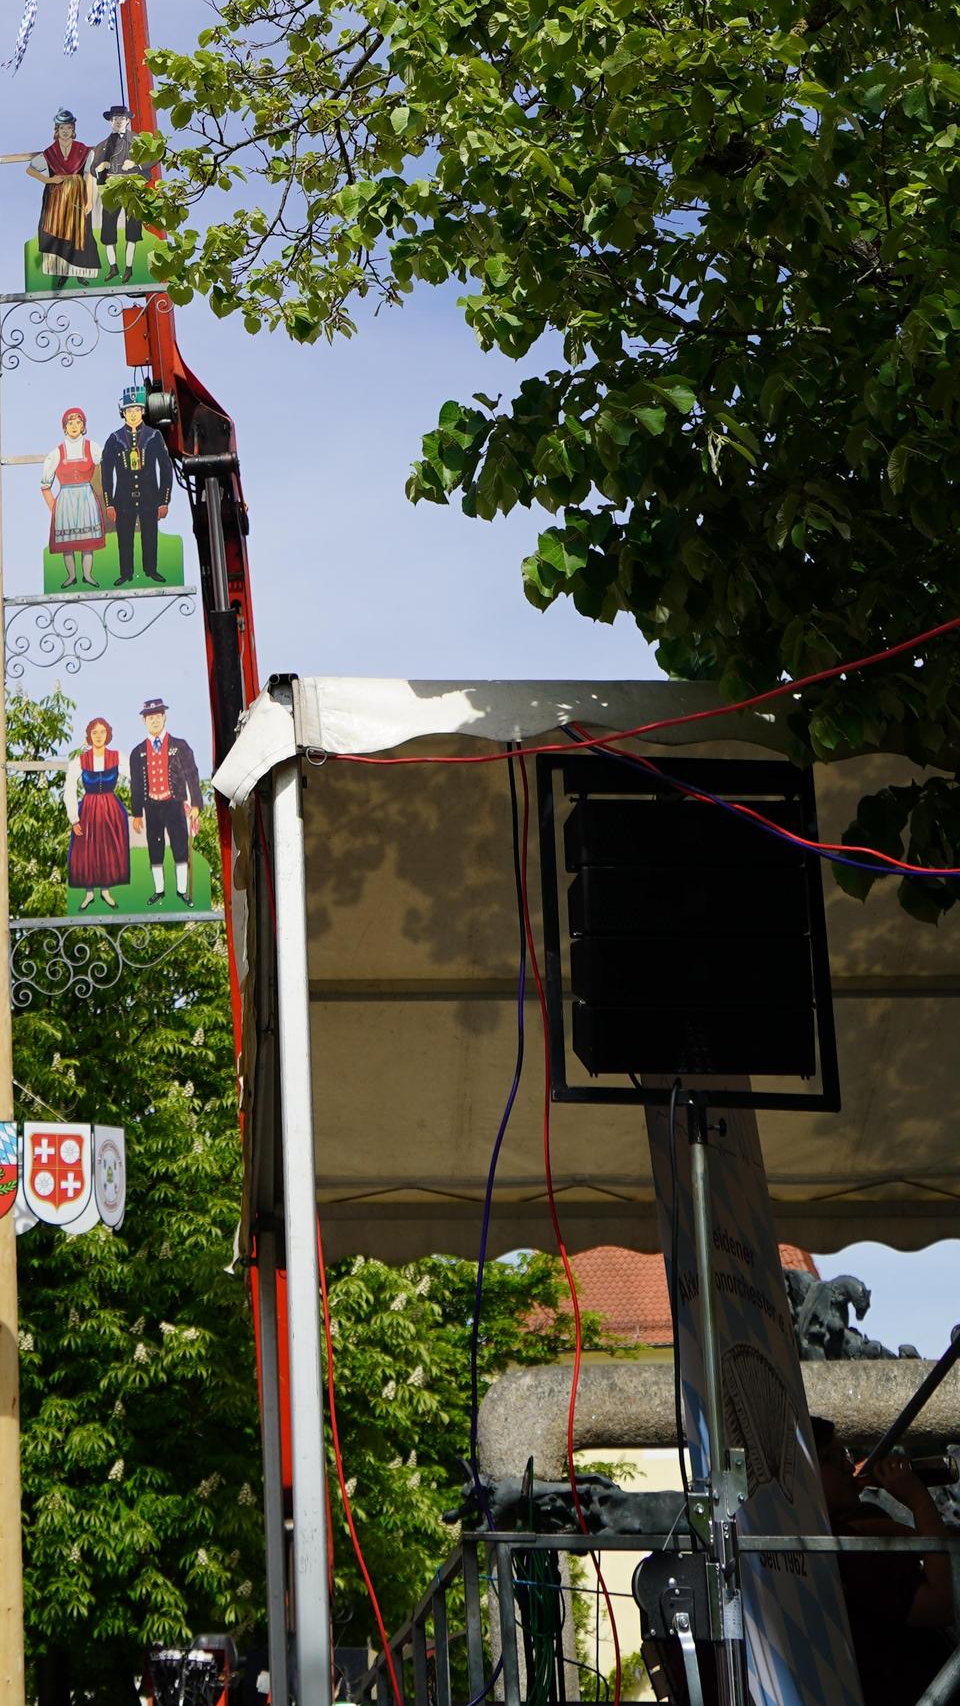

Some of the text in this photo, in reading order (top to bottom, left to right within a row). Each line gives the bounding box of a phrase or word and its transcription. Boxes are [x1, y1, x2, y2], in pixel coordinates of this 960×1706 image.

[712, 1226, 754, 1268] eidener
[678, 1270, 776, 1321] Akkonorchester
[760, 1550, 808, 1577] Seit 1962
